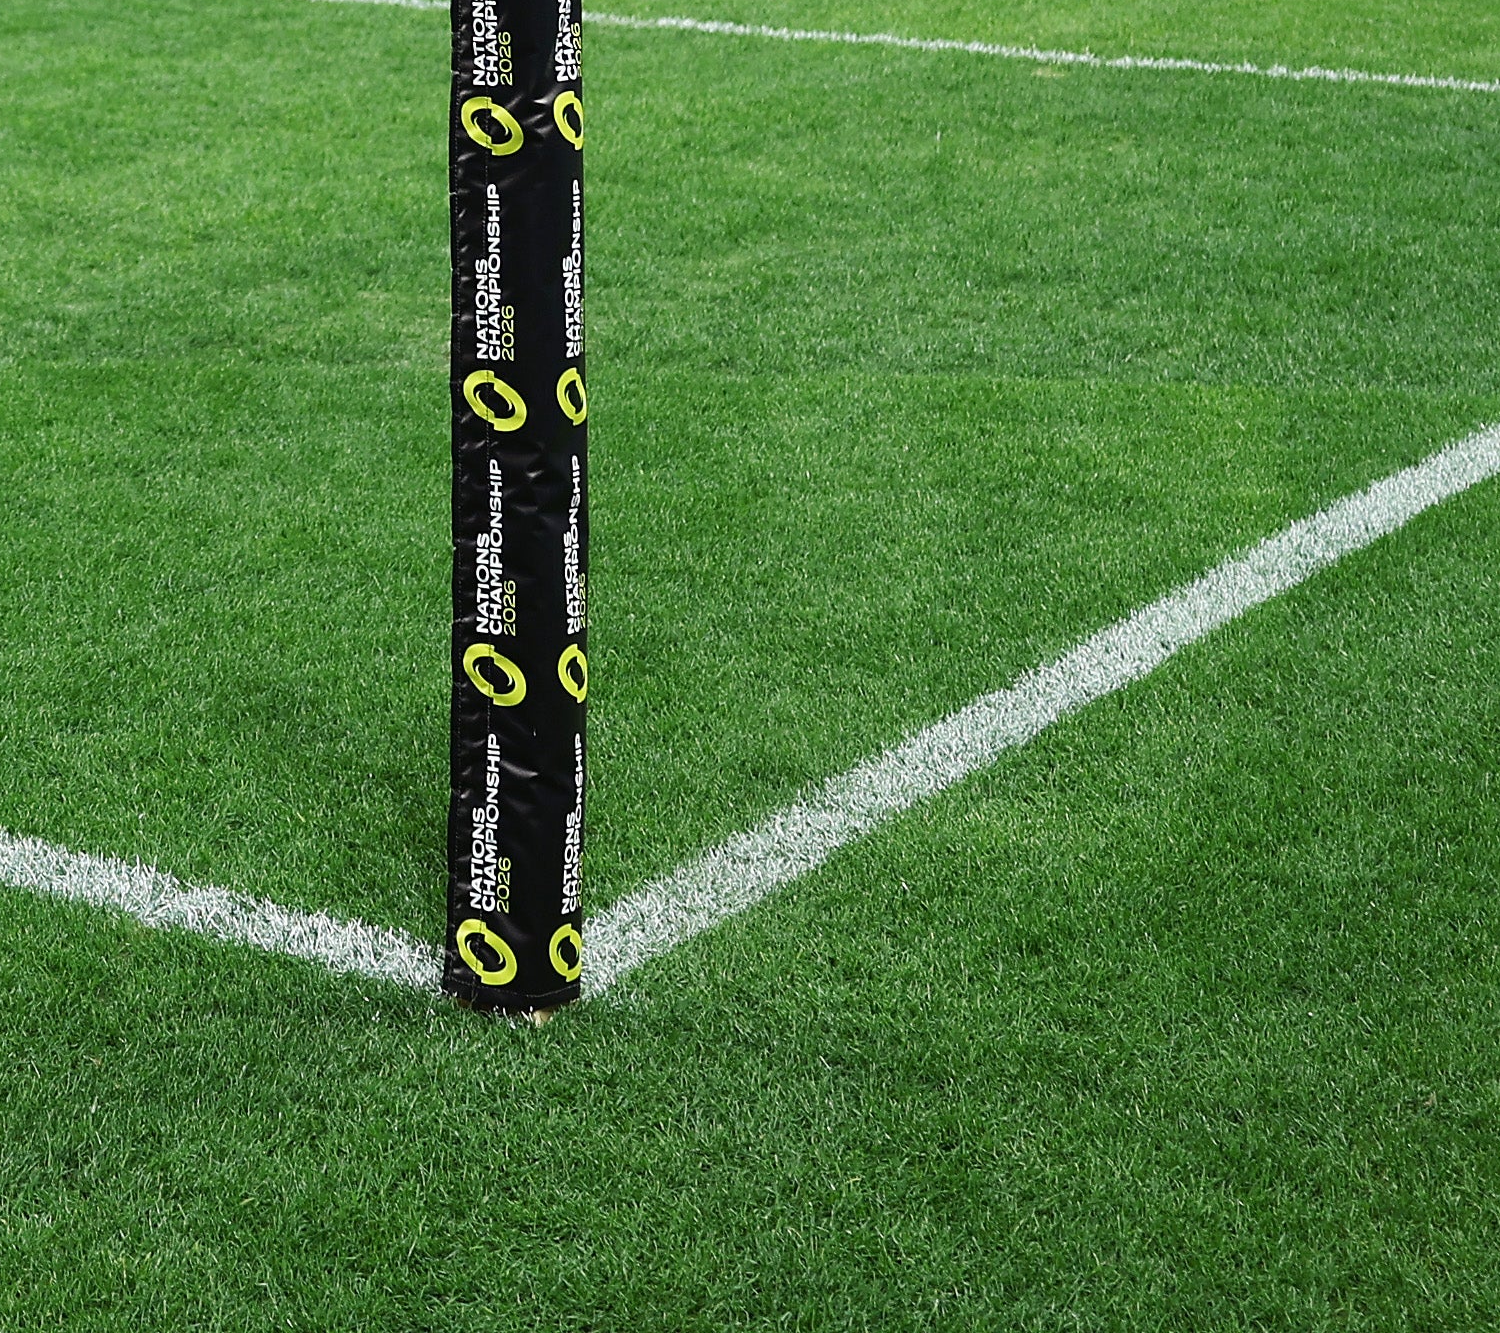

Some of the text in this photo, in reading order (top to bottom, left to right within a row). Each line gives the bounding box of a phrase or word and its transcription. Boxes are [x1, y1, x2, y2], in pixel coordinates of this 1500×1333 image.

[500, 31, 512, 86] 2026
[475, 258, 488, 360] NATIONS
[487, 184, 500, 362] CHAMPIONSHIP
[563, 255, 574, 359] NATIONS
[570, 179, 582, 357] CHAMPIONSHIP
[501, 305, 514, 362] 2026
[476, 532, 490, 634] NATIONS
[489, 459, 503, 635] CHAMPIONSHIP
[564, 531, 575, 635] NATIONS
[569, 455, 581, 634] CHAMPIONSHIP
[503, 580, 516, 636] 2026
[470, 807, 486, 910] NATIONS
[482, 733, 501, 913] CHAMPIONSHIP
[562, 812, 576, 914] NATIONS
[570, 733, 583, 913] CHAMPIONSHIP
[497, 857, 511, 914] 2026
